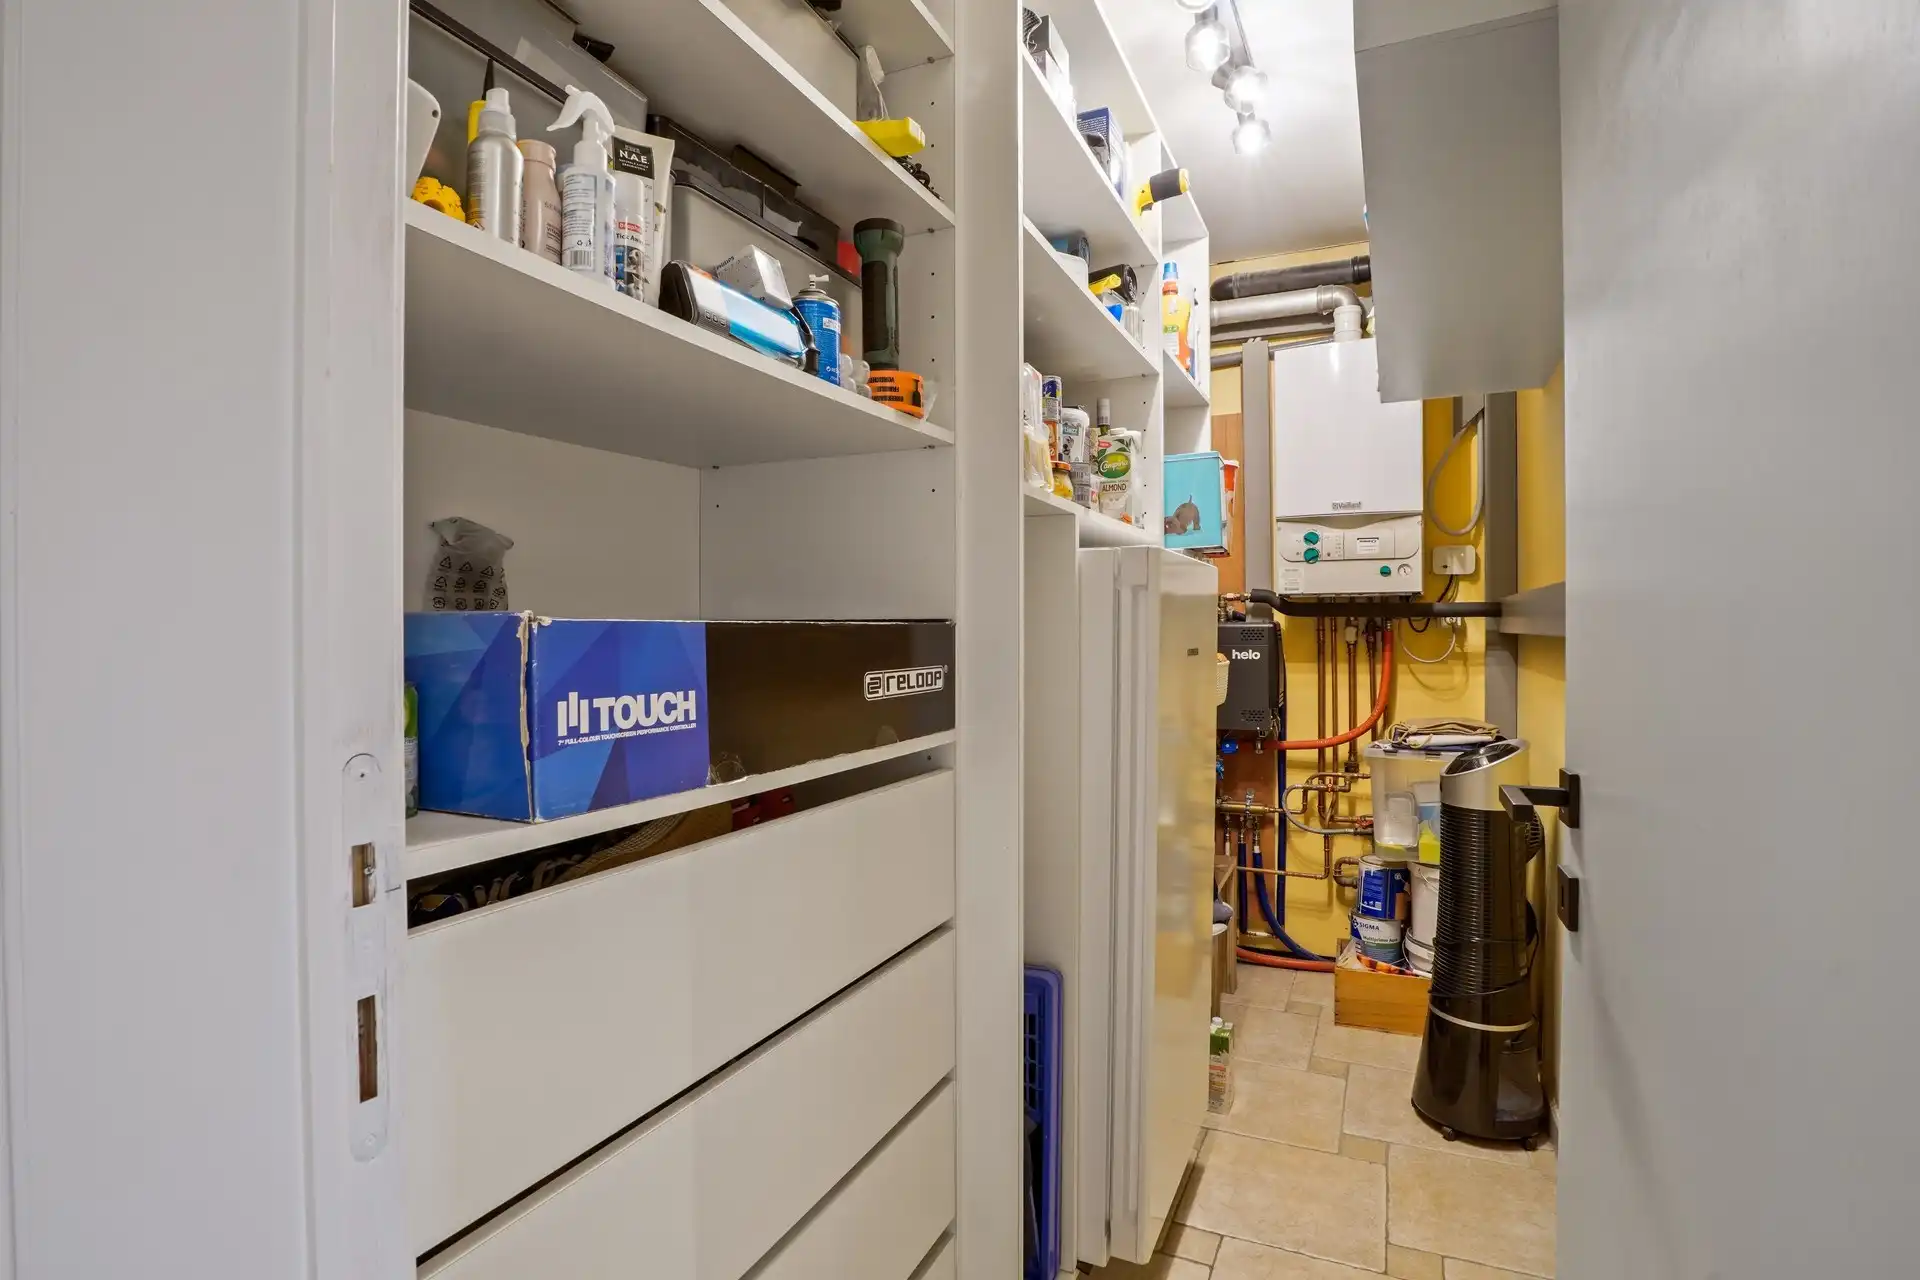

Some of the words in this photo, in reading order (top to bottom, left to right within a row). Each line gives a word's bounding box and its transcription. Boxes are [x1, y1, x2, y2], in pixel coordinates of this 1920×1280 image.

[619, 149, 650, 165] N.A.E.
[1102, 482, 1126, 492] ALMOND
[1232, 649, 1260, 660] helo
[593, 690, 697, 731] TOUCH
[565, 733, 601, 745] FULL-COLOUR
[601, 729, 637, 741] TOUCHSCREEN
[637, 726, 669, 737] PERFORMANCE
[670, 722, 697, 732] CONTROLLER
[1359, 922, 1380, 931] SIGMA
